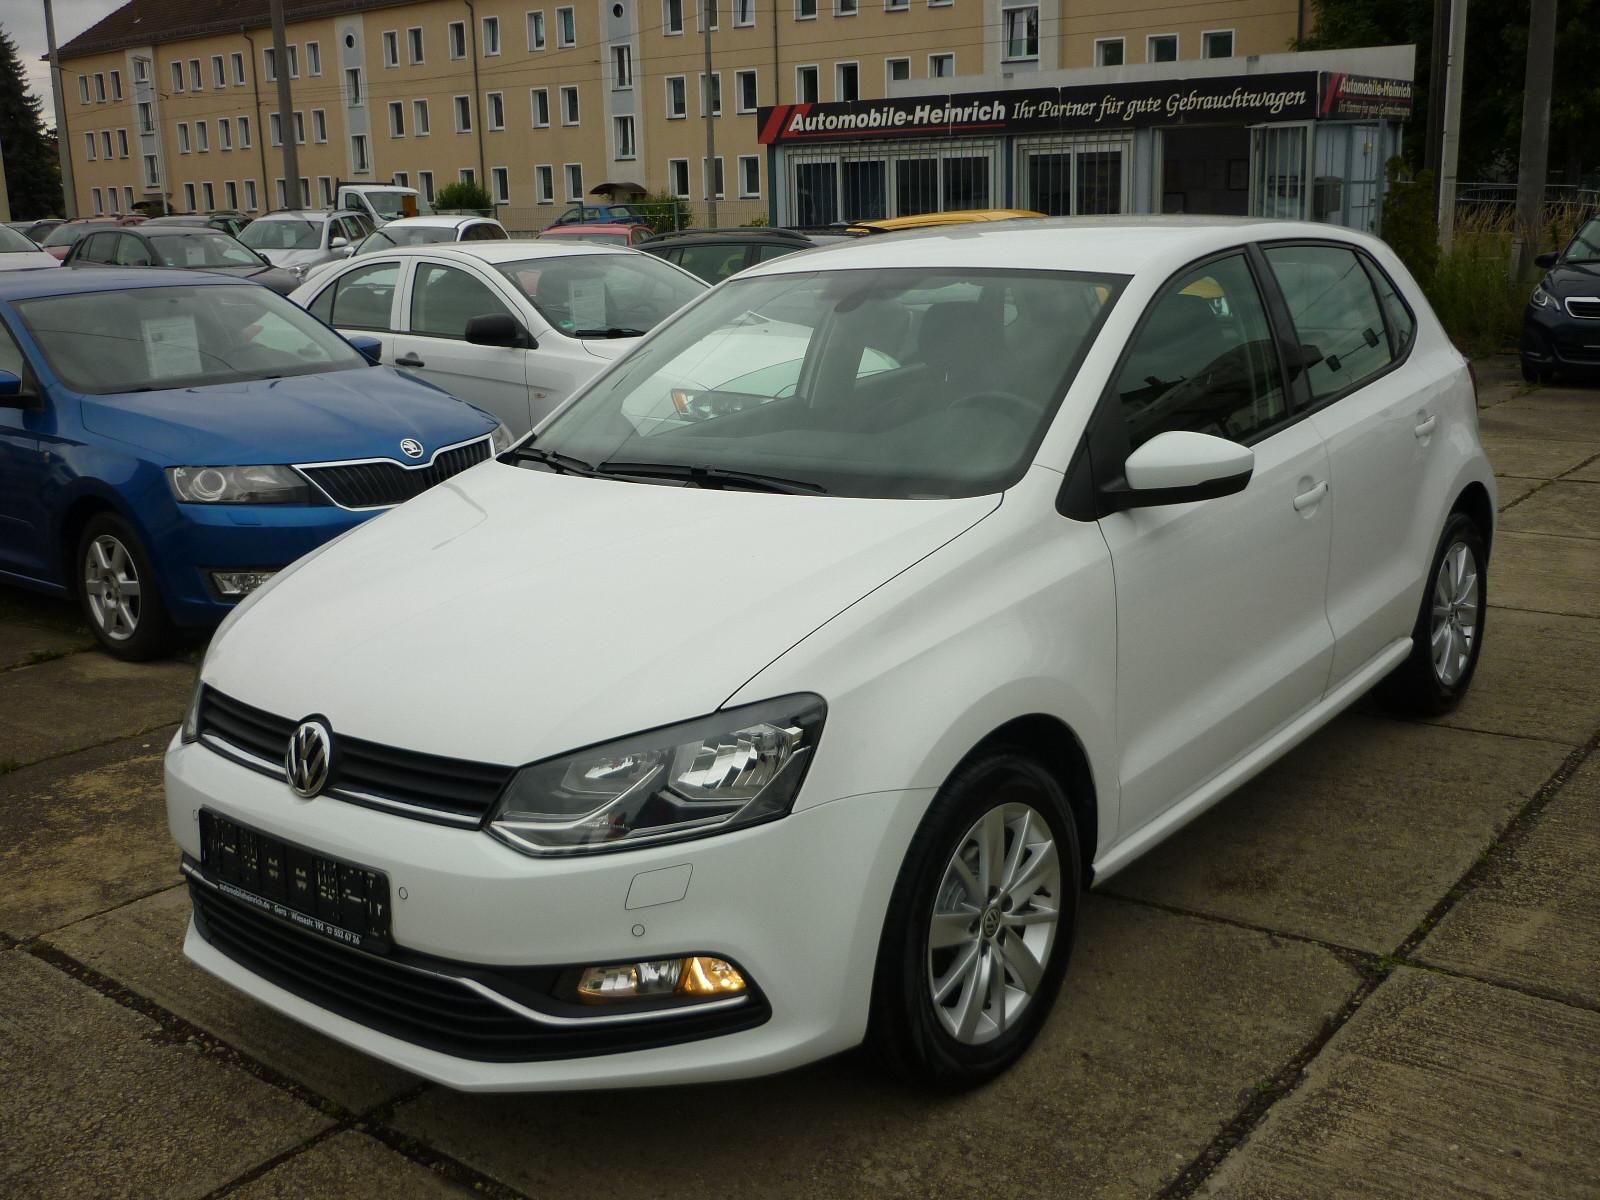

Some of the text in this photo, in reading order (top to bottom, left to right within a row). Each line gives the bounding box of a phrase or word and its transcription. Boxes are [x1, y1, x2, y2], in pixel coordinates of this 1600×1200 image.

[1340, 77, 1411, 98] Automobile-Heinrich
[788, 87, 1306, 132] Automobile-Heinrich Ihr Partner für gute Gebrauchtwagen
